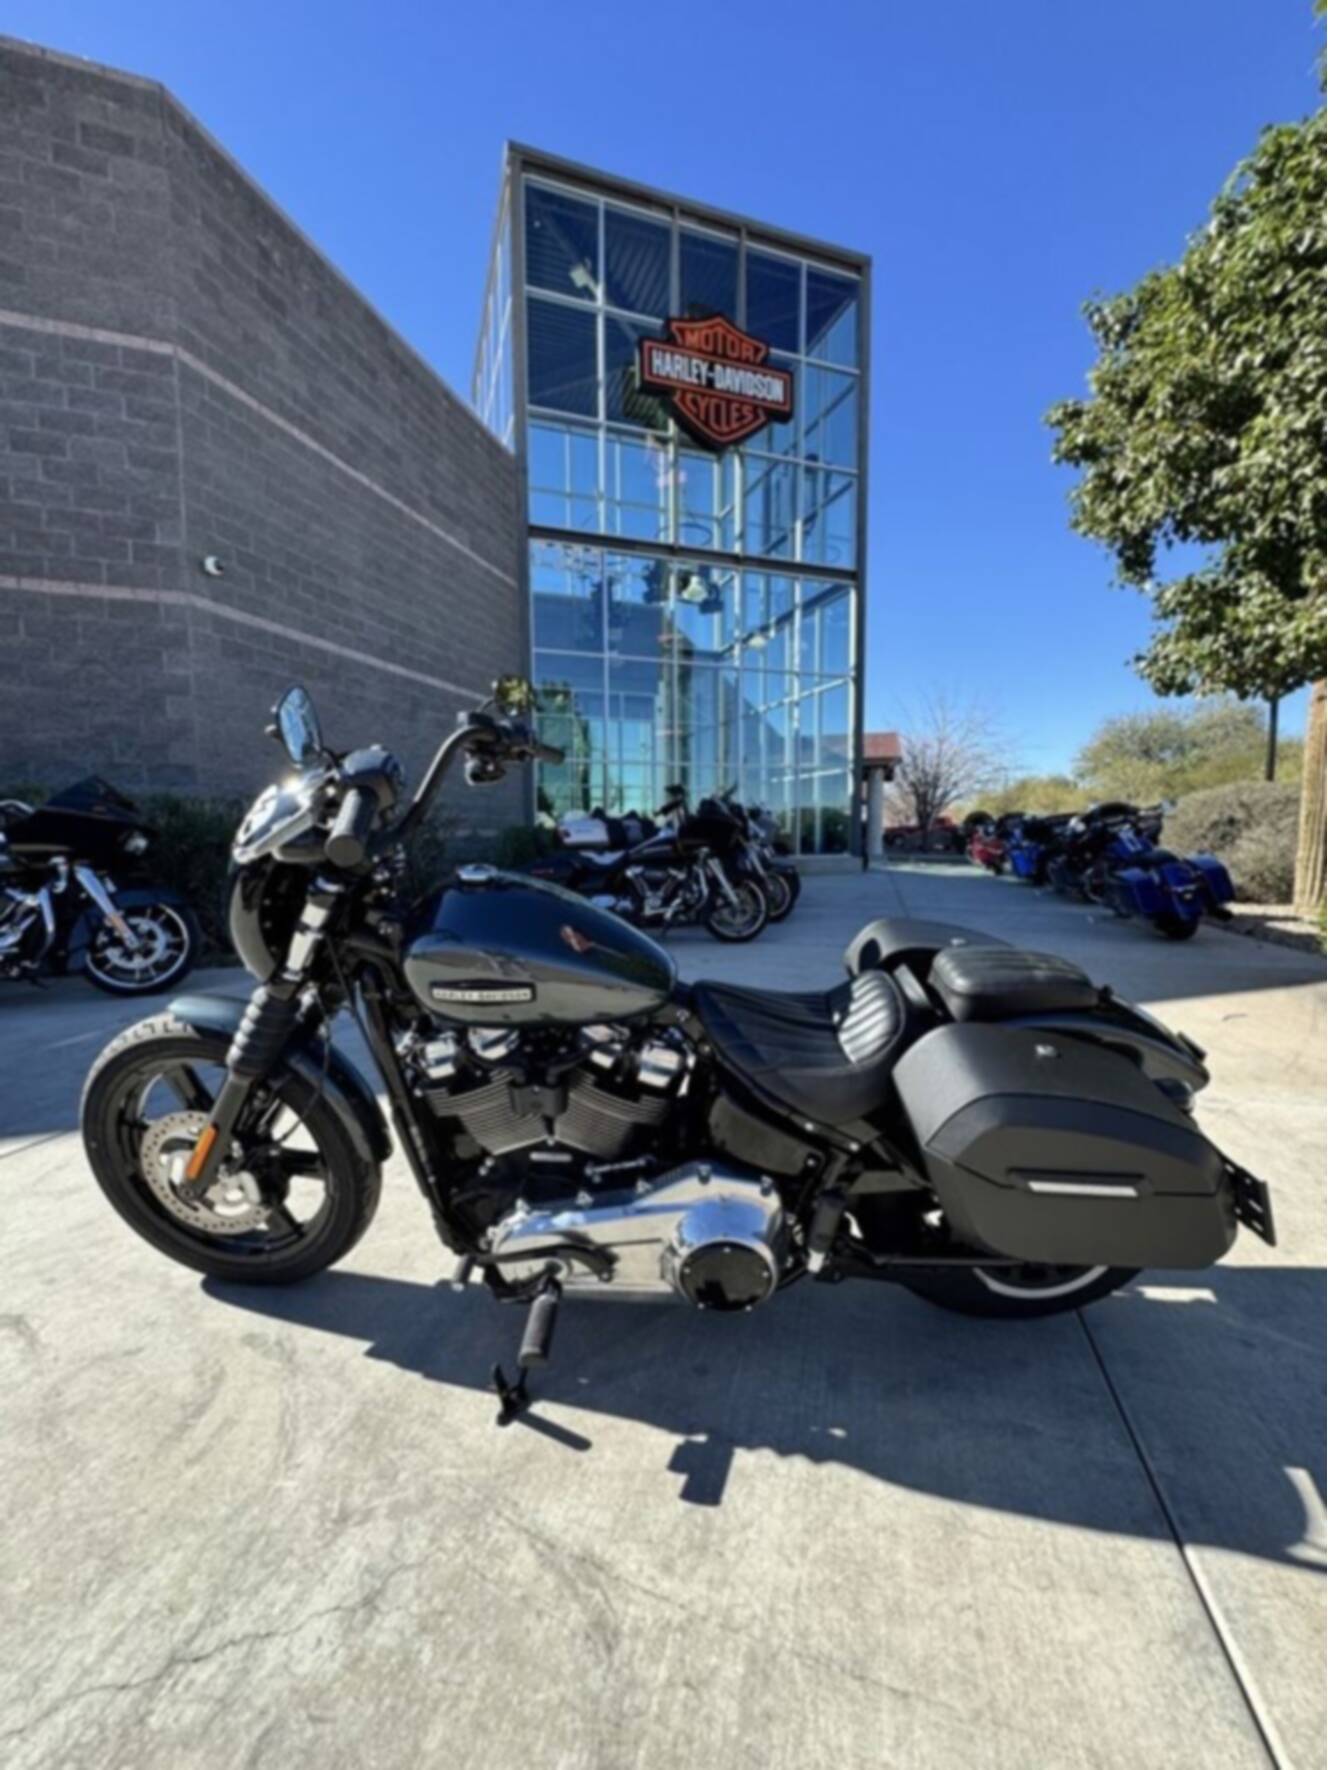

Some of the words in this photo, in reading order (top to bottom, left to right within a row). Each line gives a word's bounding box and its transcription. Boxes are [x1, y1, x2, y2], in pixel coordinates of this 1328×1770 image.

[684, 327, 756, 363] MOTOR
[651, 348, 784, 403] HARLEY-DAVIDSON
[684, 391, 754, 432] CYCLES
